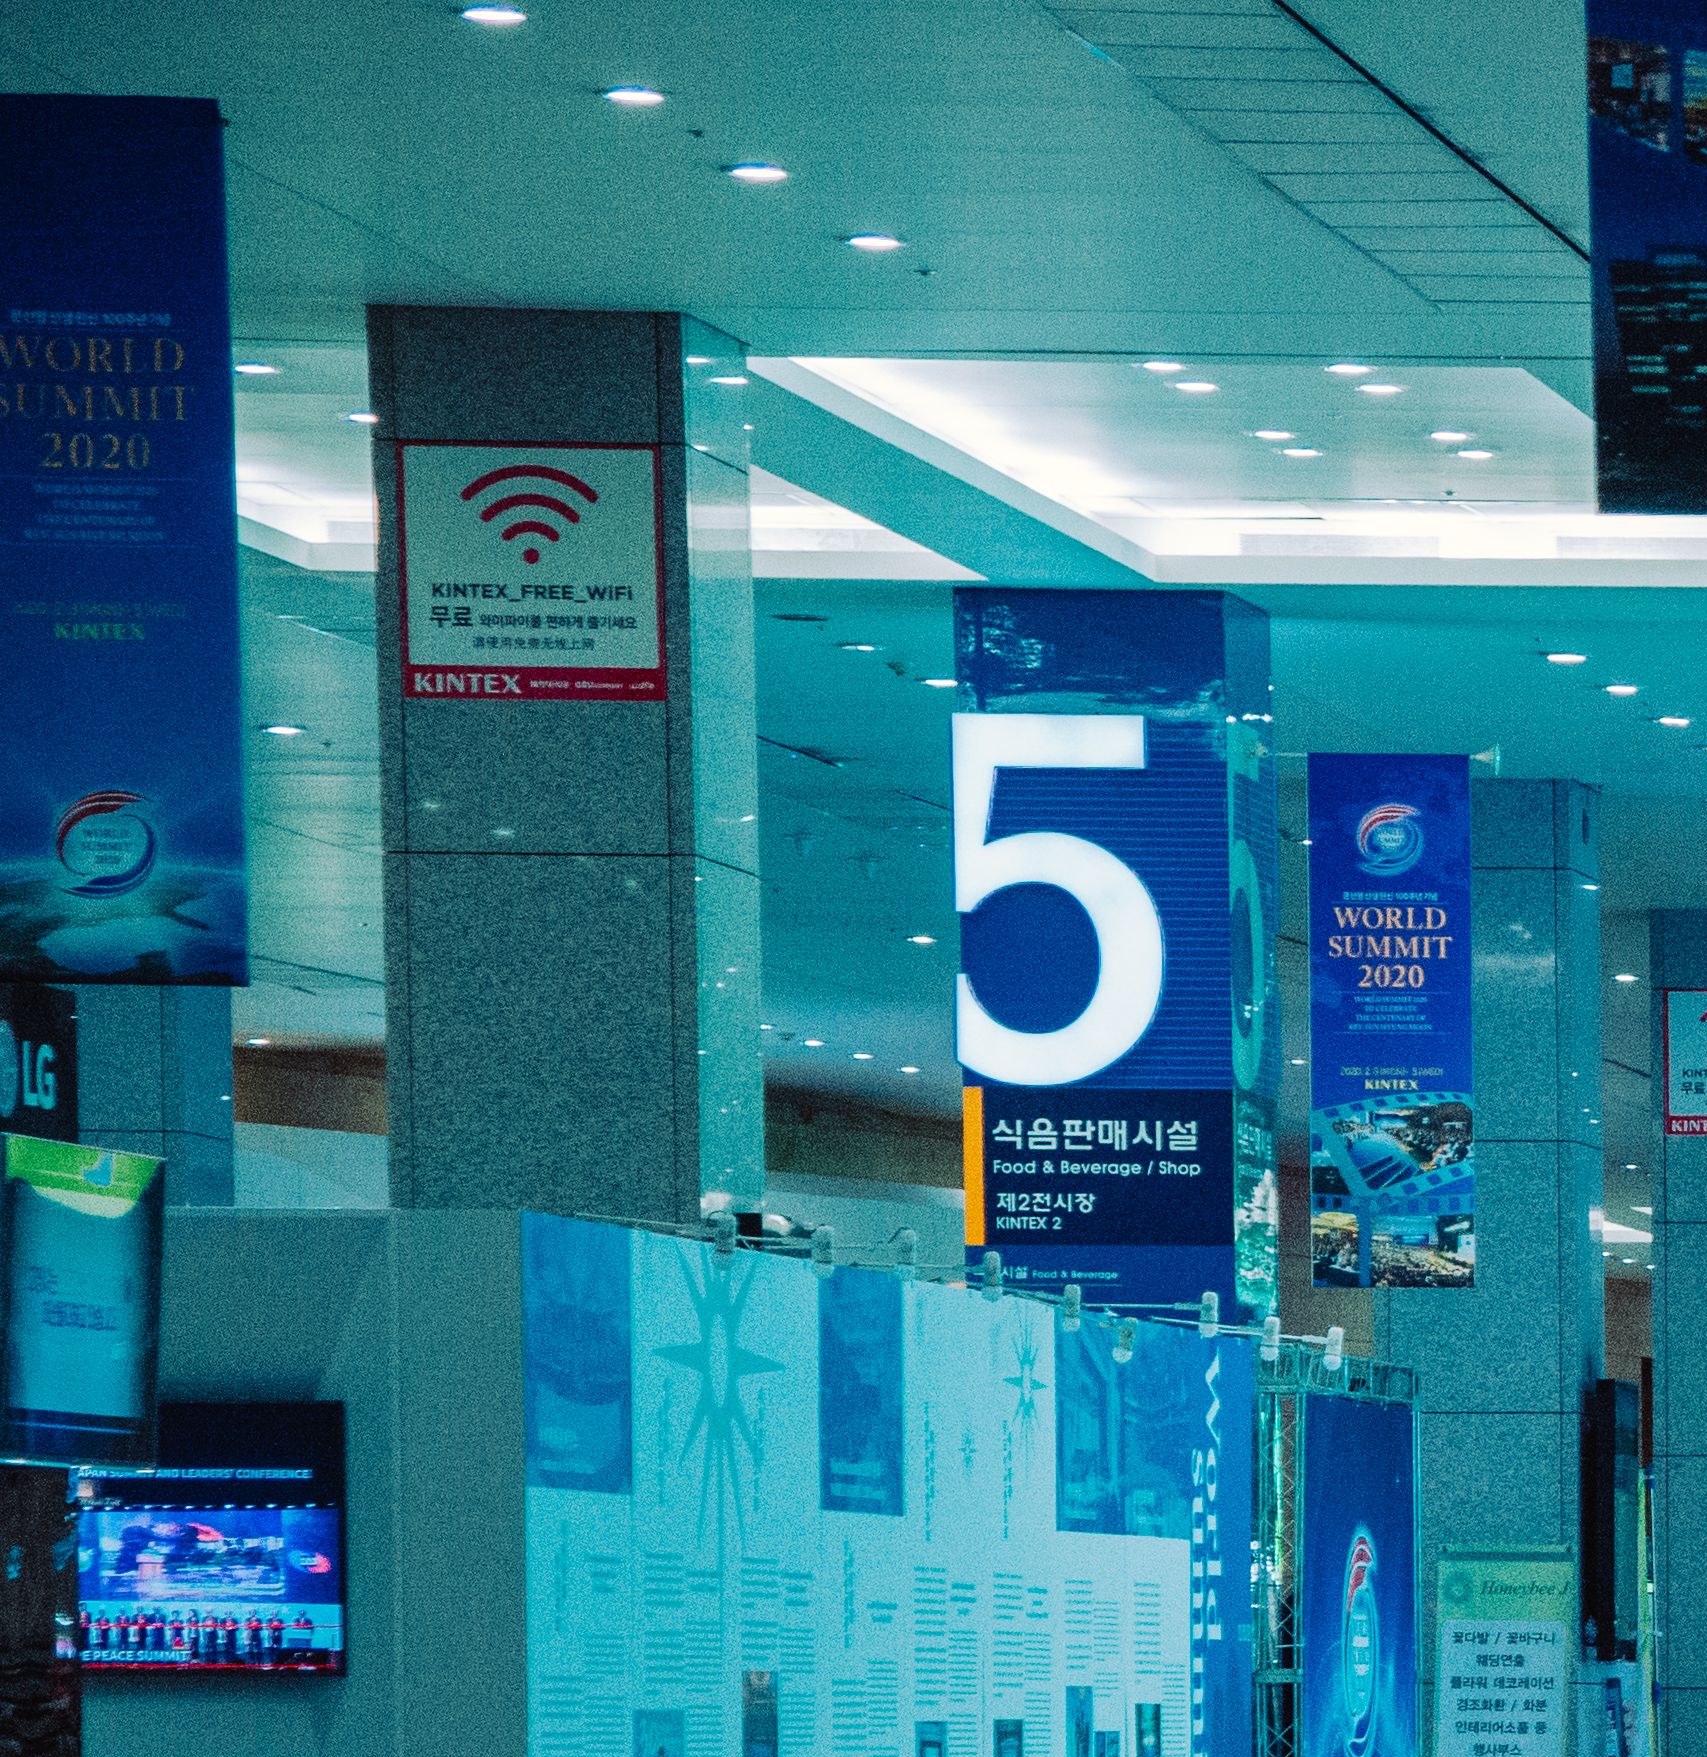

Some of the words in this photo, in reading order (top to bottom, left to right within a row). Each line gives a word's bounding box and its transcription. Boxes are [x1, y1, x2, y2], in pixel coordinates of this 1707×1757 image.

[41, 432, 150, 469] 2020
[430, 605, 473, 628] 무료
[479, 614, 541, 629] 와이파이를
[414, 672, 522, 694] KINTEX
[951, 713, 1165, 1086] 5
[1333, 907, 1447, 931] WORLD
[1328, 935, 1453, 959] SUMMIT
[1357, 964, 1425, 988] 2020
[1364, 1079, 1419, 1090] KINTEX
[1681, 1081, 1705, 1095] 무료
[992, 1117, 1198, 1152] 식음판매시설
[993, 1159, 1037, 1174] Food
[1042, 1159, 1055, 1175] &
[1060, 1159, 1142, 1177] Beverage
[1146, 1161, 1155, 1176] /
[1158, 1161, 1202, 1177] Shop
[996, 1192, 1096, 1214] 제2전시장
[996, 1216, 1048, 1230] KINTEX
[1052, 1217, 1063, 1230] 2
[156, 1468, 180, 1479] AND
[236, 1468, 311, 1480] CONFERENCE
[93, 1650, 135, 1661] PEACE
[137, 1650, 190, 1662] SUMMIT
